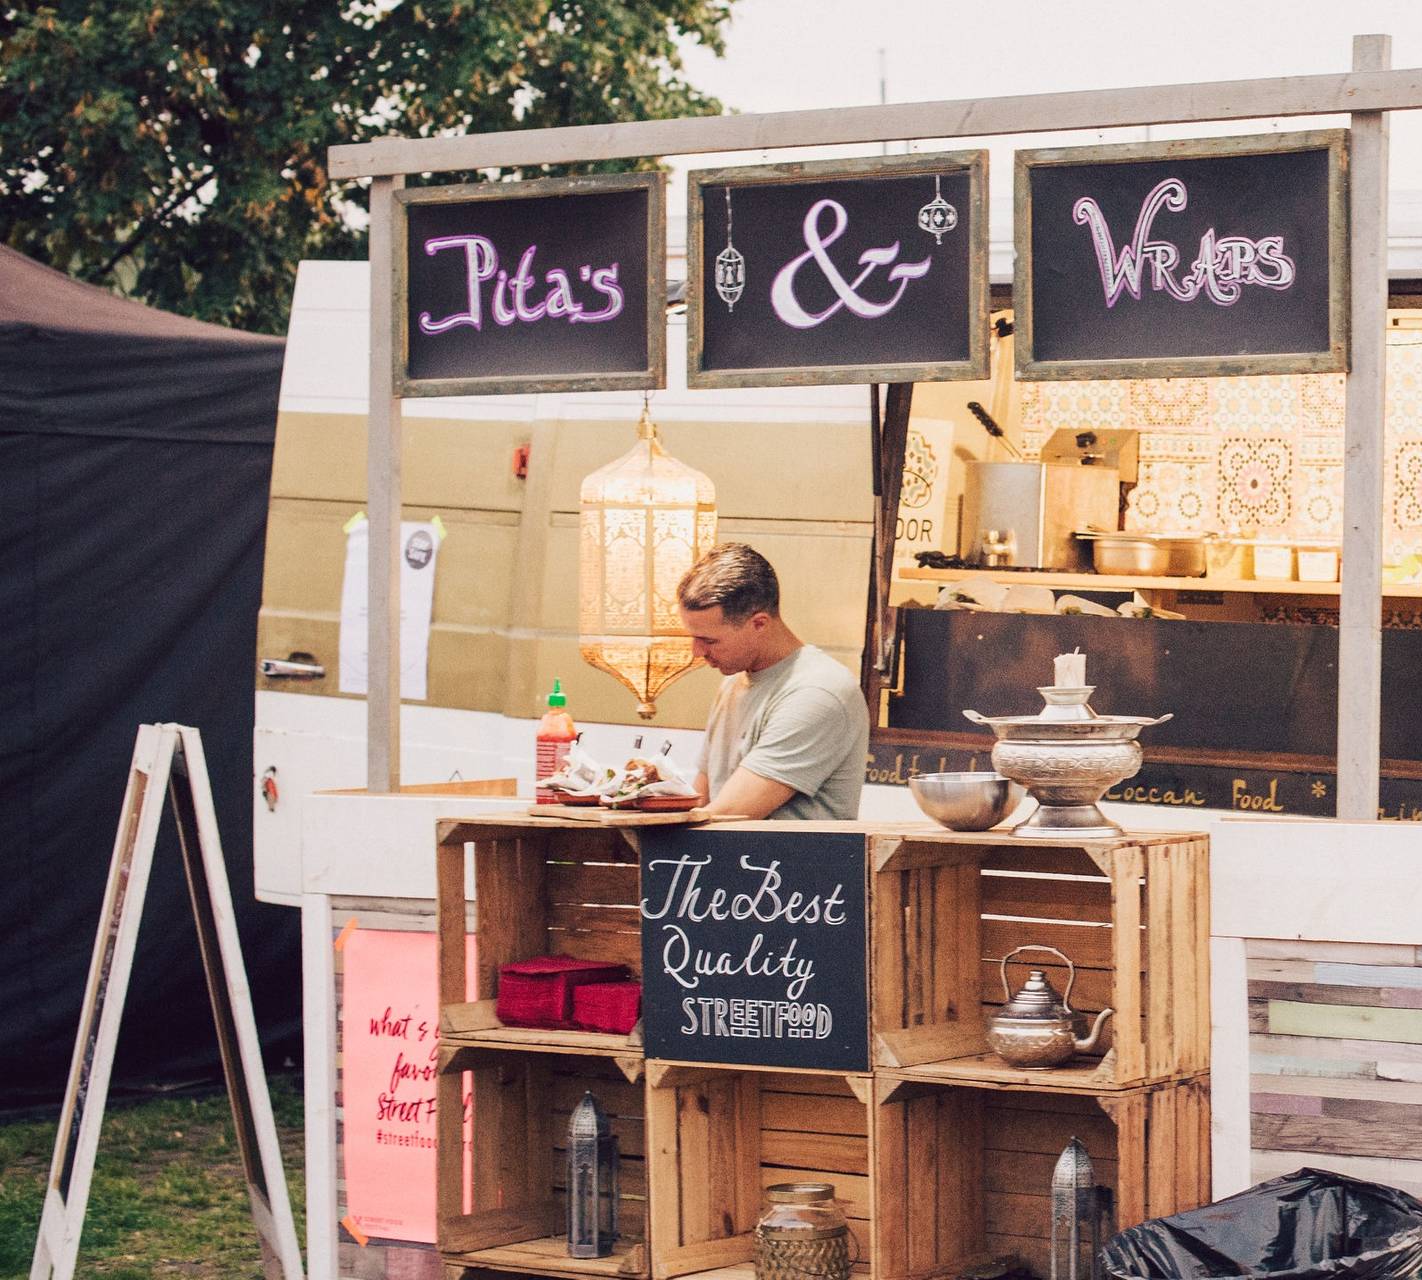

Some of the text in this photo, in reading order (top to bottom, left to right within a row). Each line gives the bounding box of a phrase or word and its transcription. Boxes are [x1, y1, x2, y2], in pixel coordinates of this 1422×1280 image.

[419, 234, 625, 336] Pita's
[771, 199, 932, 329] &
[1232, 778, 1284, 812] Food
[640, 854, 847, 926] The Best
[662, 924, 816, 1000] Quality
